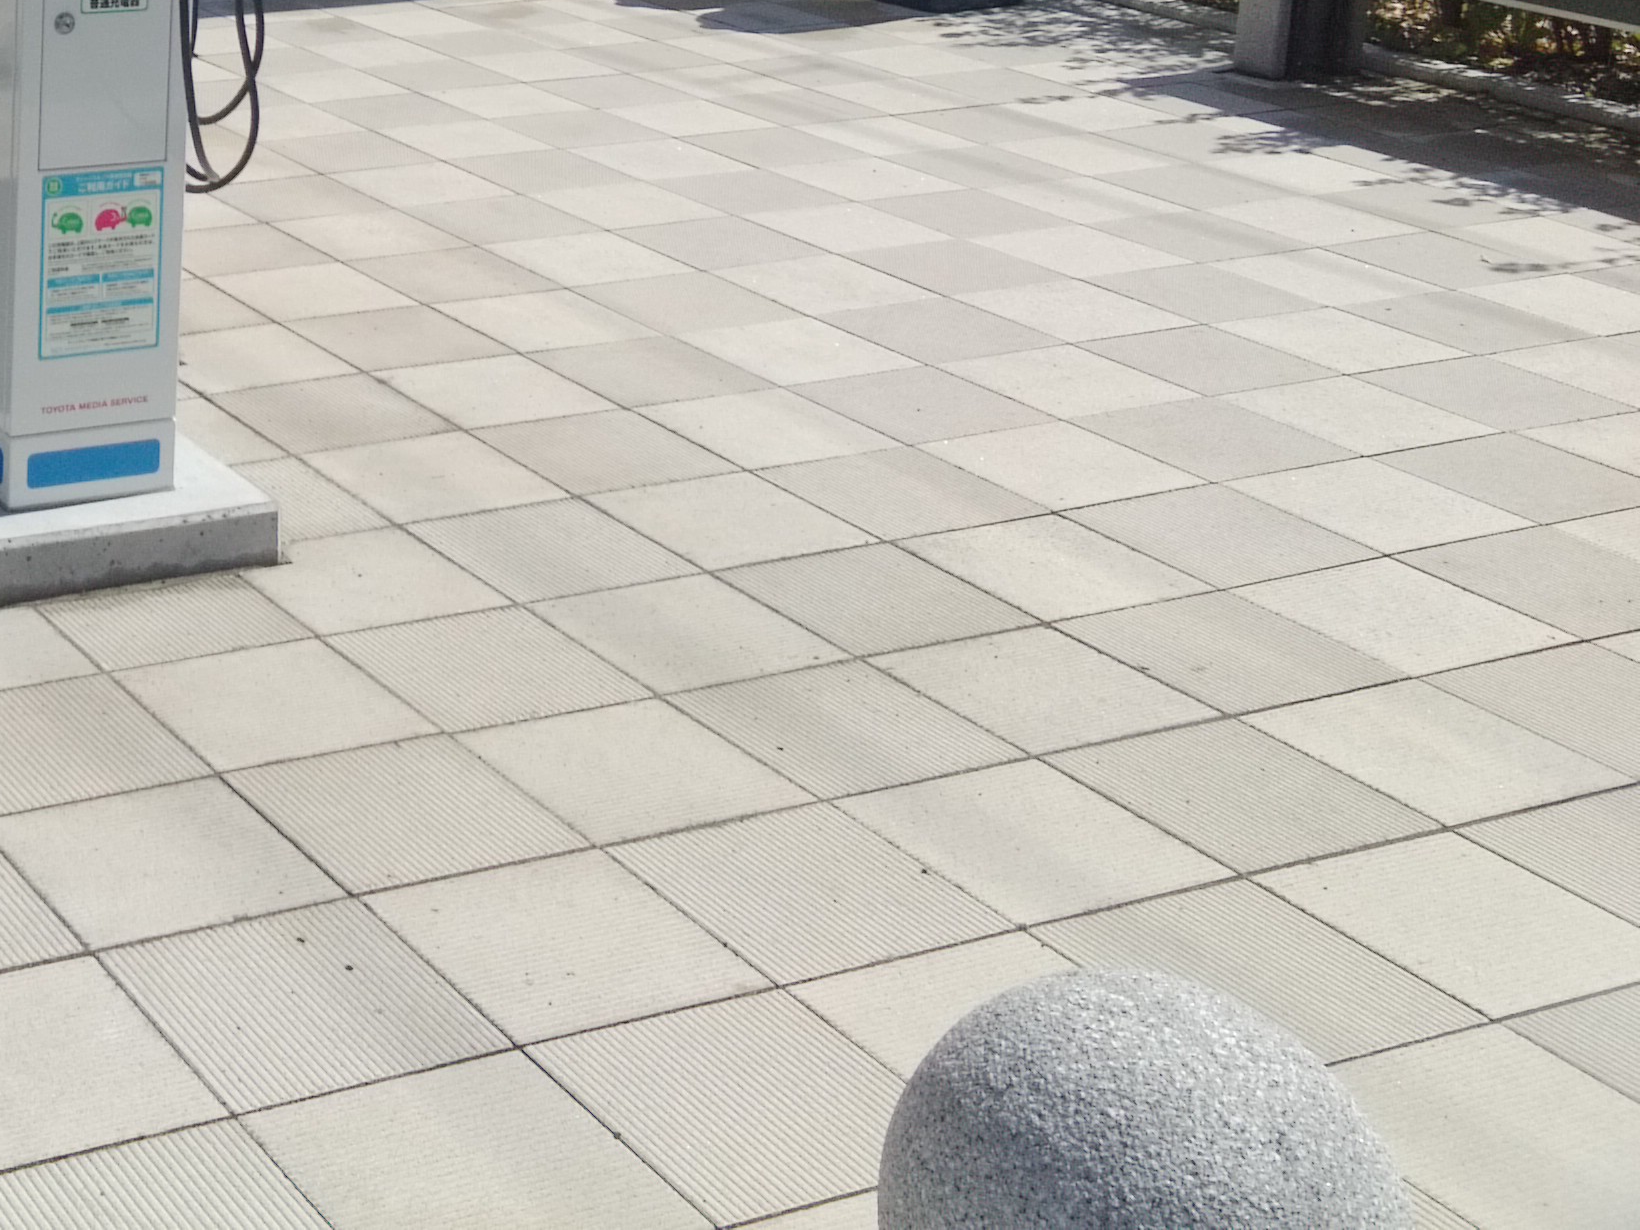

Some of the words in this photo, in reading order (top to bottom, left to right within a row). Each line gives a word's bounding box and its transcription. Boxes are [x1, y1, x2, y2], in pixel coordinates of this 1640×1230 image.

[41, 404, 76, 414] TOYOTA
[78, 400, 108, 410] MEDIA
[110, 395, 149, 407] SERVICE
